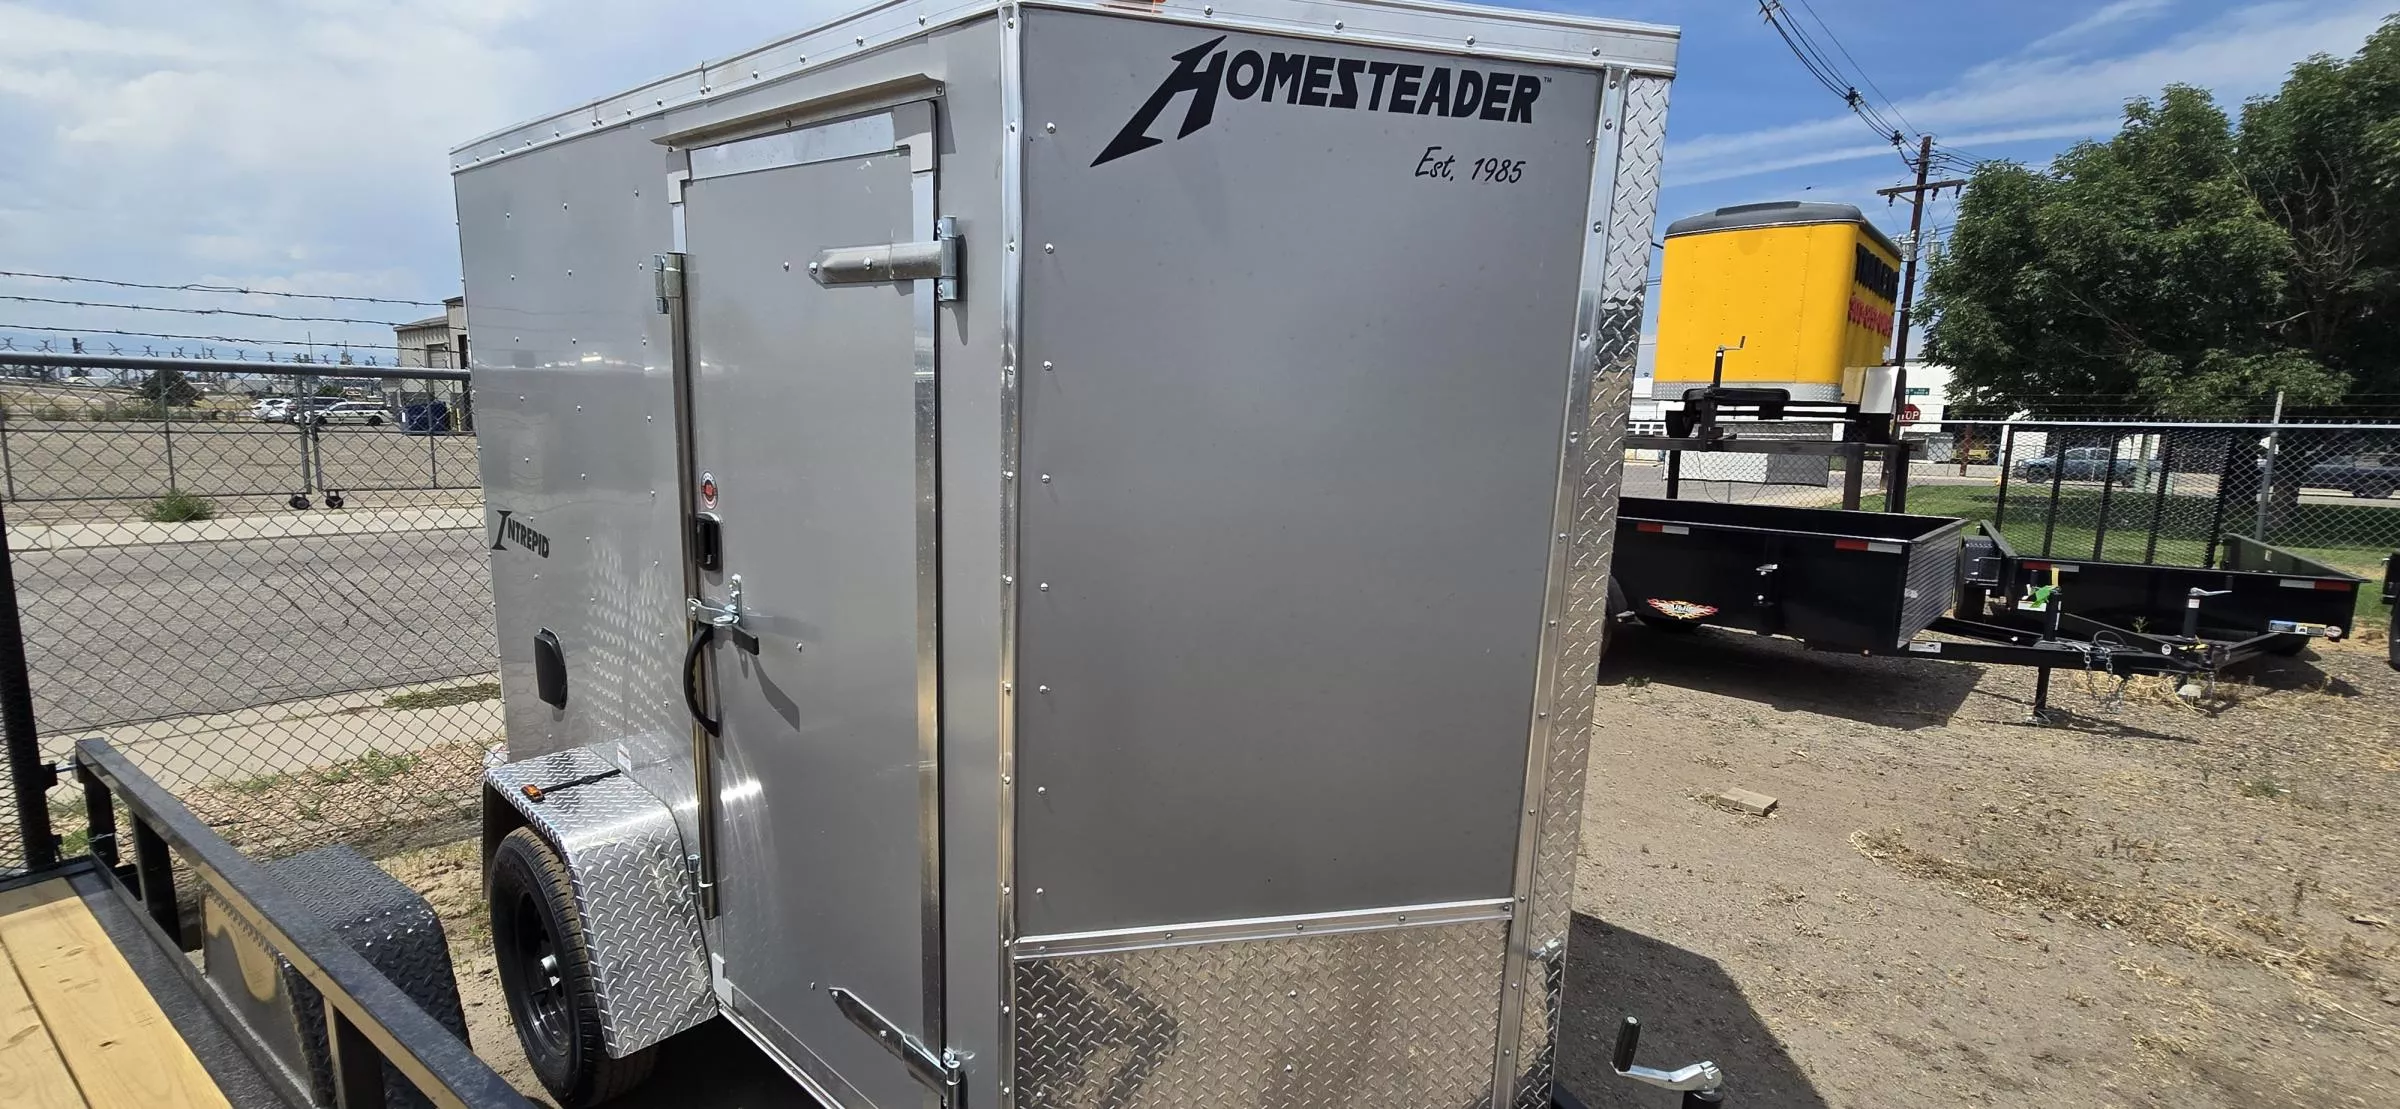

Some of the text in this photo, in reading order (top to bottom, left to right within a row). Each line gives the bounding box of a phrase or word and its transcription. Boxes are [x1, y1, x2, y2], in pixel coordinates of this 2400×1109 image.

[1089, 35, 1541, 168] HOMESTEADER
[1415, 146, 1526, 184] Est. 1985
[491, 510, 550, 559] INTREPID
